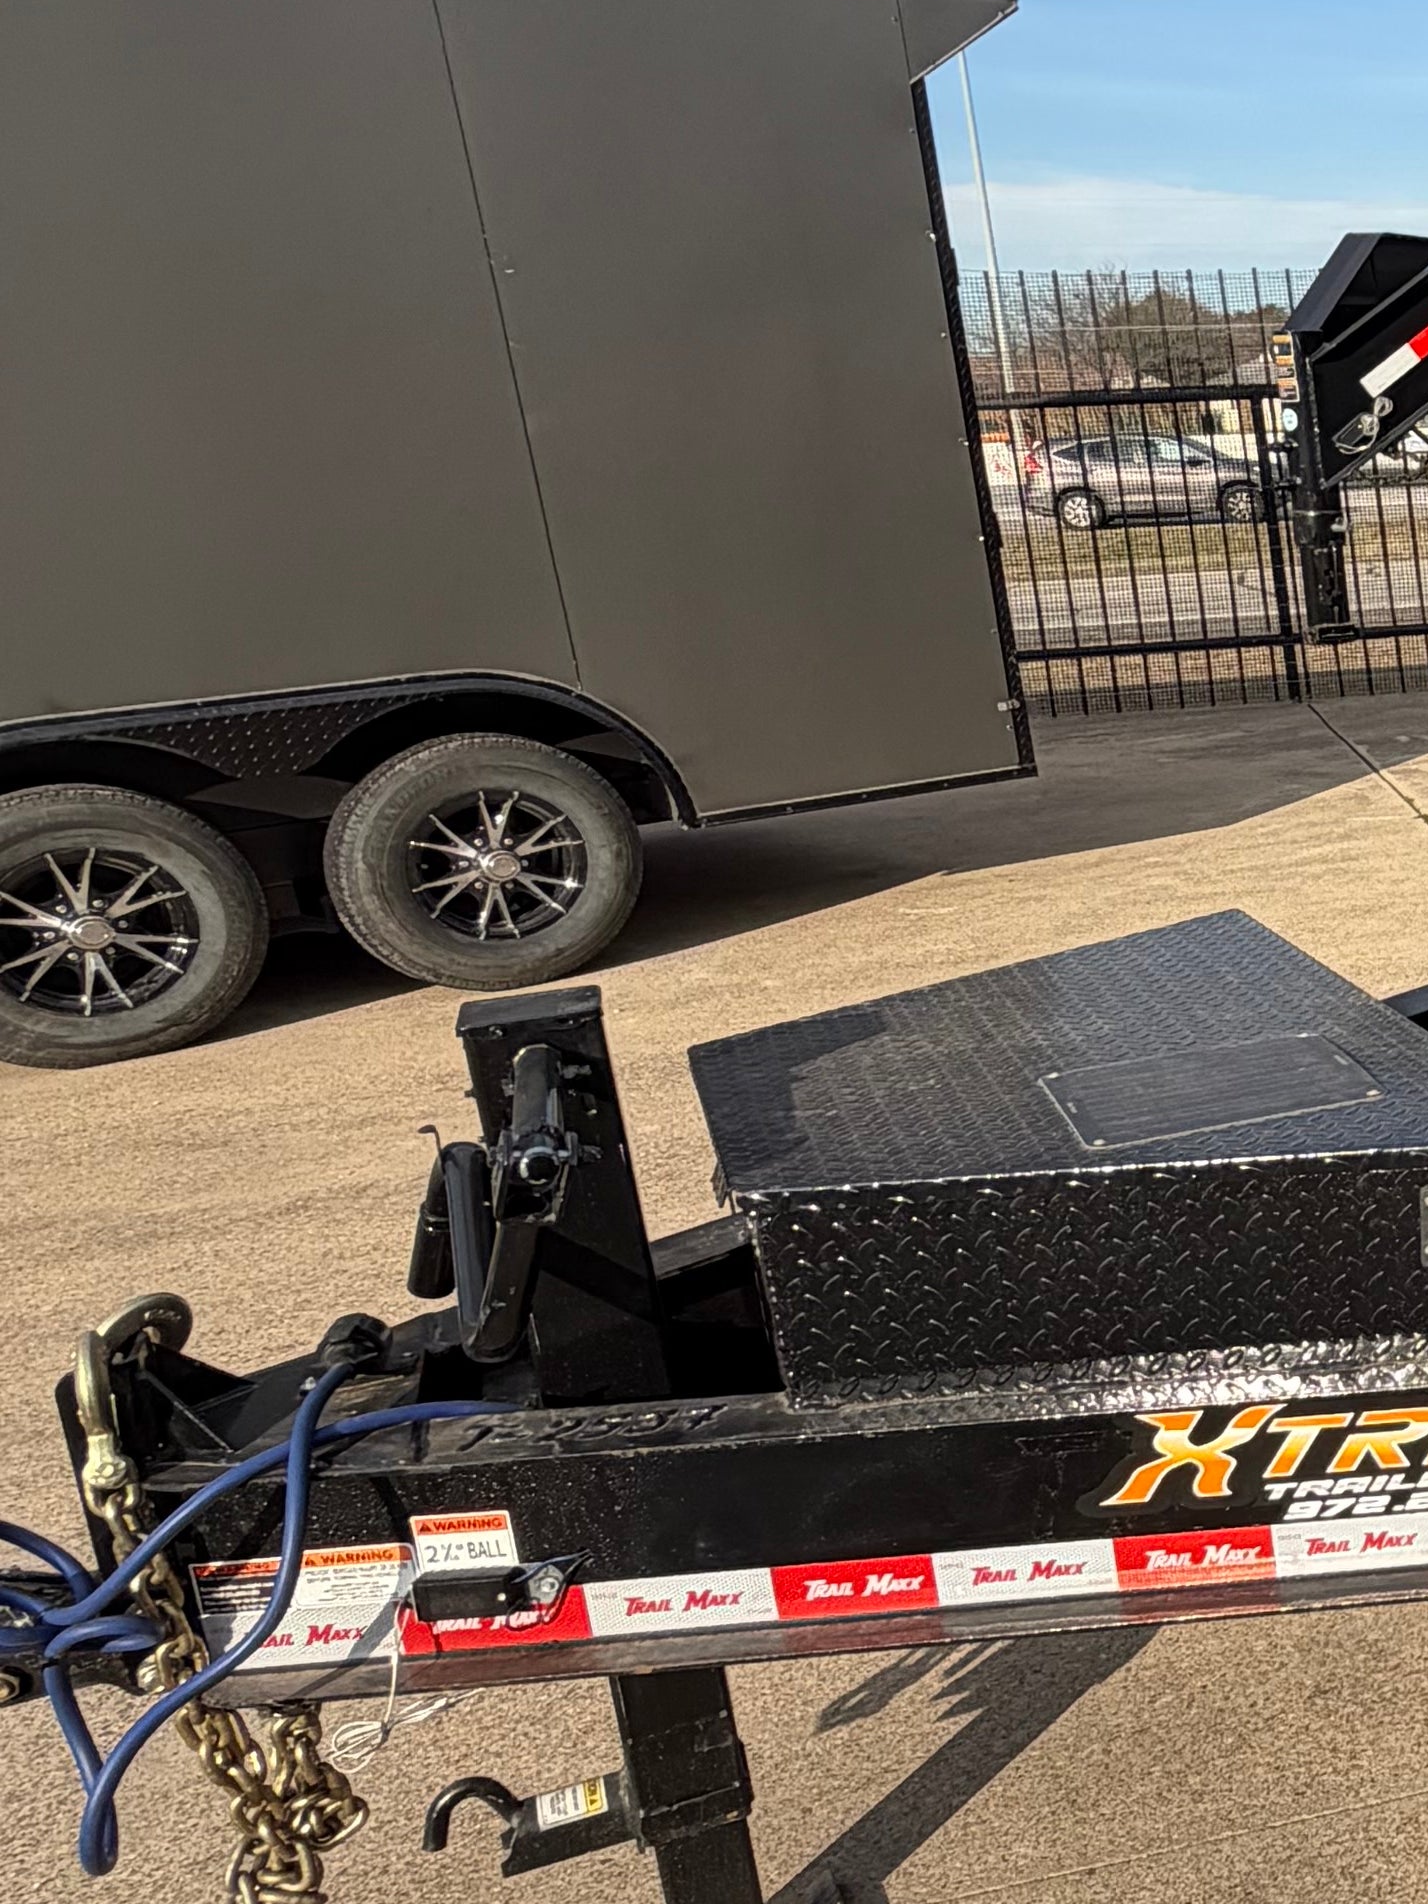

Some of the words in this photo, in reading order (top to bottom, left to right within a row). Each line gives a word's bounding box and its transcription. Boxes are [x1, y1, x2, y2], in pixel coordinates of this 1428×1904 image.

[434, 1517, 502, 1531] WARNING
[468, 1539, 508, 1560] BALL
[1305, 1537, 1350, 1556] TRAIL
[1359, 1531, 1418, 1552] MAXX
[320, 1549, 394, 1565] WARNING
[1145, 1549, 1192, 1570] TRAIL
[1201, 1544, 1261, 1564] MAXX
[970, 1567, 1018, 1586] TRAIL
[1027, 1559, 1087, 1581] MAXX
[804, 1579, 854, 1601] TRAIL
[860, 1573, 925, 1596] MAXX
[624, 1595, 672, 1616] TRAIL
[682, 1589, 744, 1612] MAXX
[260, 1633, 295, 1648] AIL
[304, 1623, 368, 1647] MAXX
